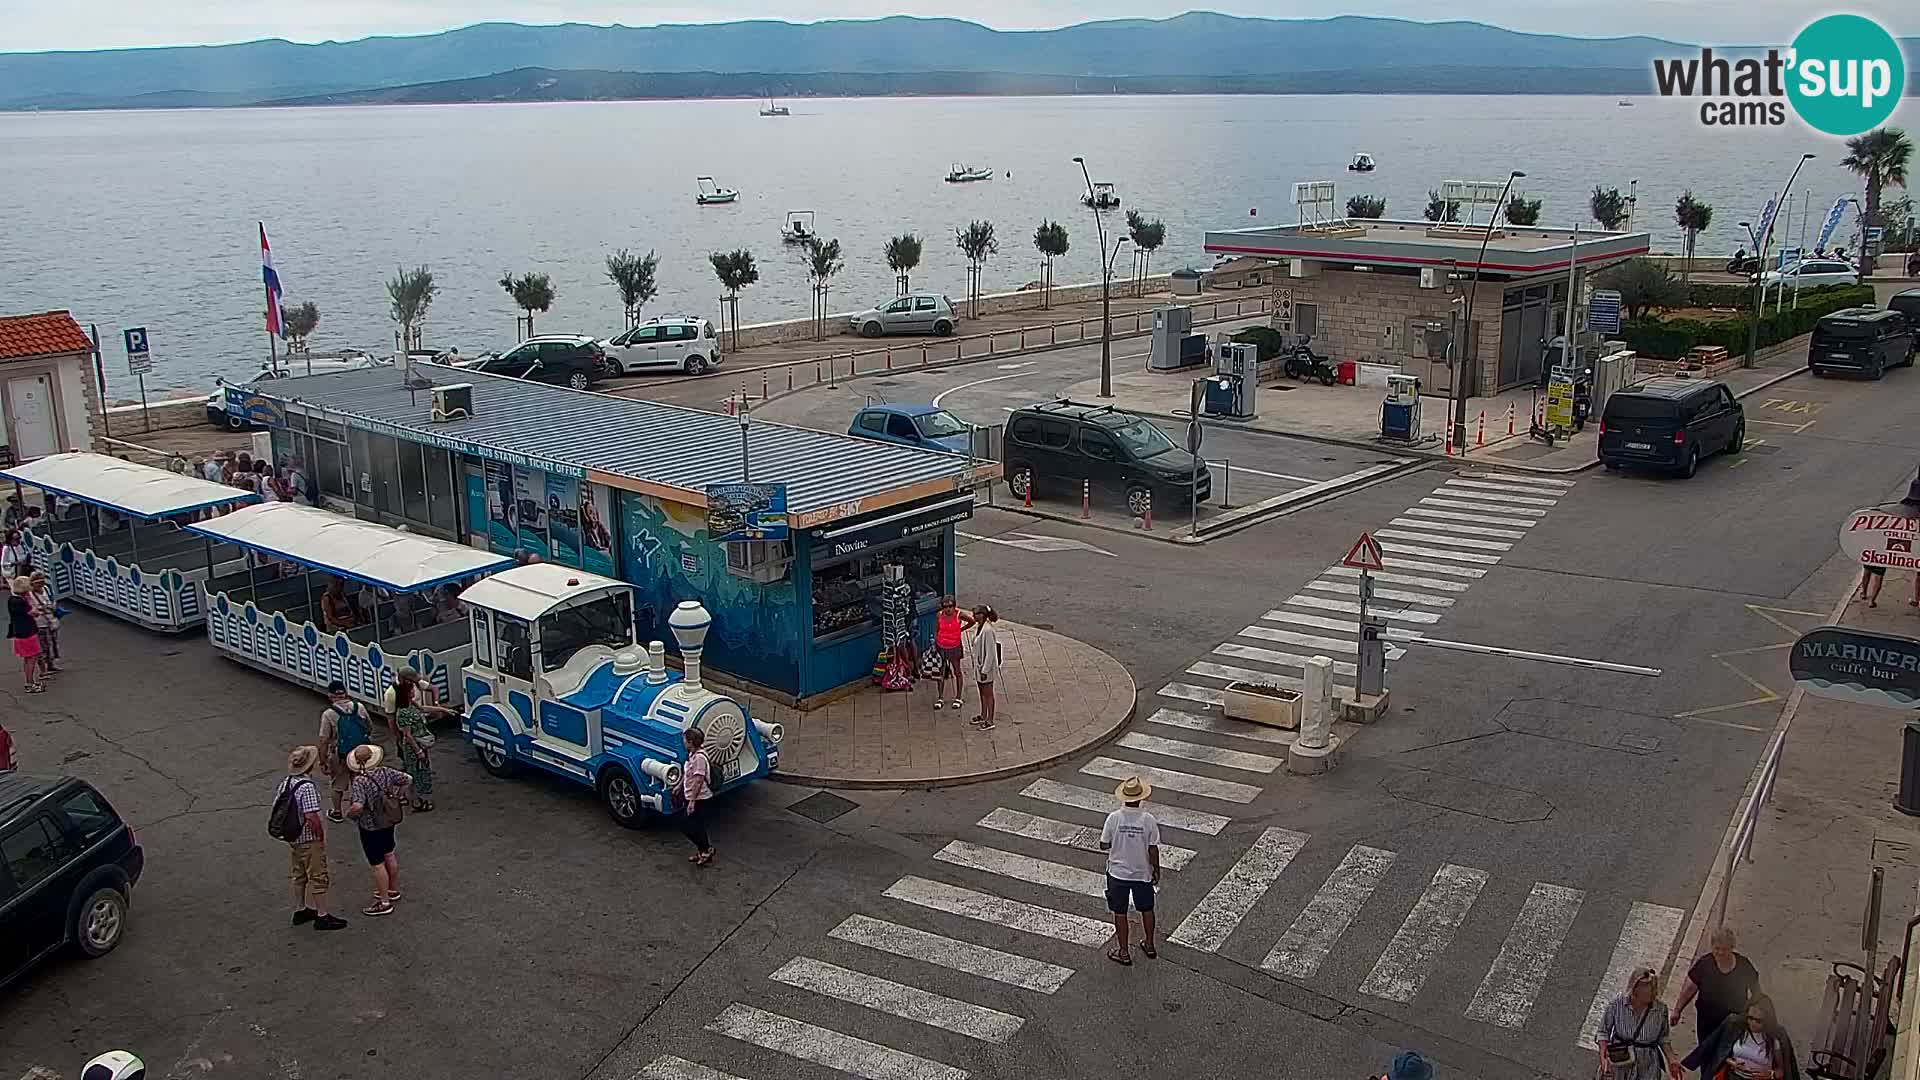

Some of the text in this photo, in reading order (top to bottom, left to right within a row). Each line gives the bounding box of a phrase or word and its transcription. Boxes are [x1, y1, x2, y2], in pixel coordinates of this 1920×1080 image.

[130, 331, 142, 350] P
[436, 437, 468, 453] POSTAJA
[478, 446, 583, 478] BUS STATION TICKET OFFICE
[1850, 515, 1920, 532] PIZZE
[1883, 530, 1919, 541] GRILL
[1801, 642, 1920, 673] MARINER
[1830, 661, 1899, 680] caffe bar
